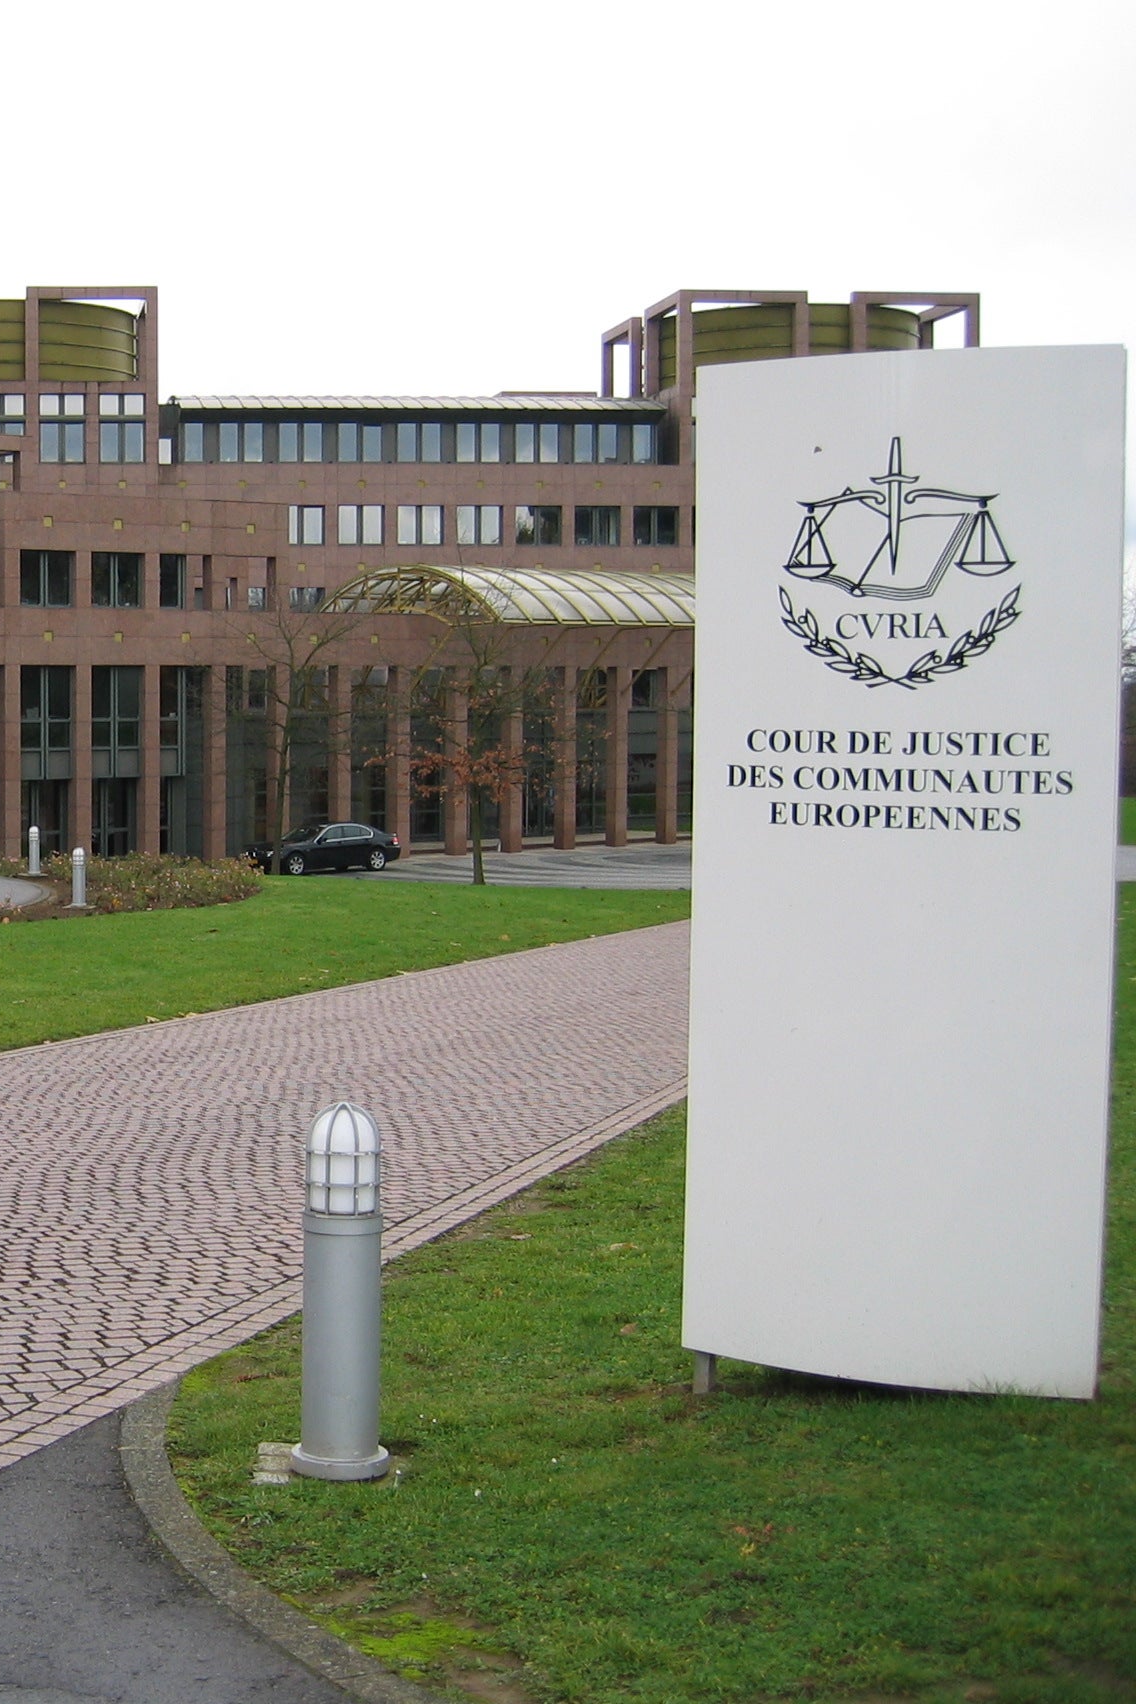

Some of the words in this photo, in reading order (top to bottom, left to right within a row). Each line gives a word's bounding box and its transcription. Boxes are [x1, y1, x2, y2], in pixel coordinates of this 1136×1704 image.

[835, 612, 950, 640] CVRIA
[746, 728, 839, 754] COUR
[848, 730, 892, 755] DE
[901, 731, 1051, 757] JUSTICE
[727, 764, 784, 789] DES
[793, 765, 1074, 795] COMMUNAUTES
[769, 801, 1022, 832] EUROPEENNES
